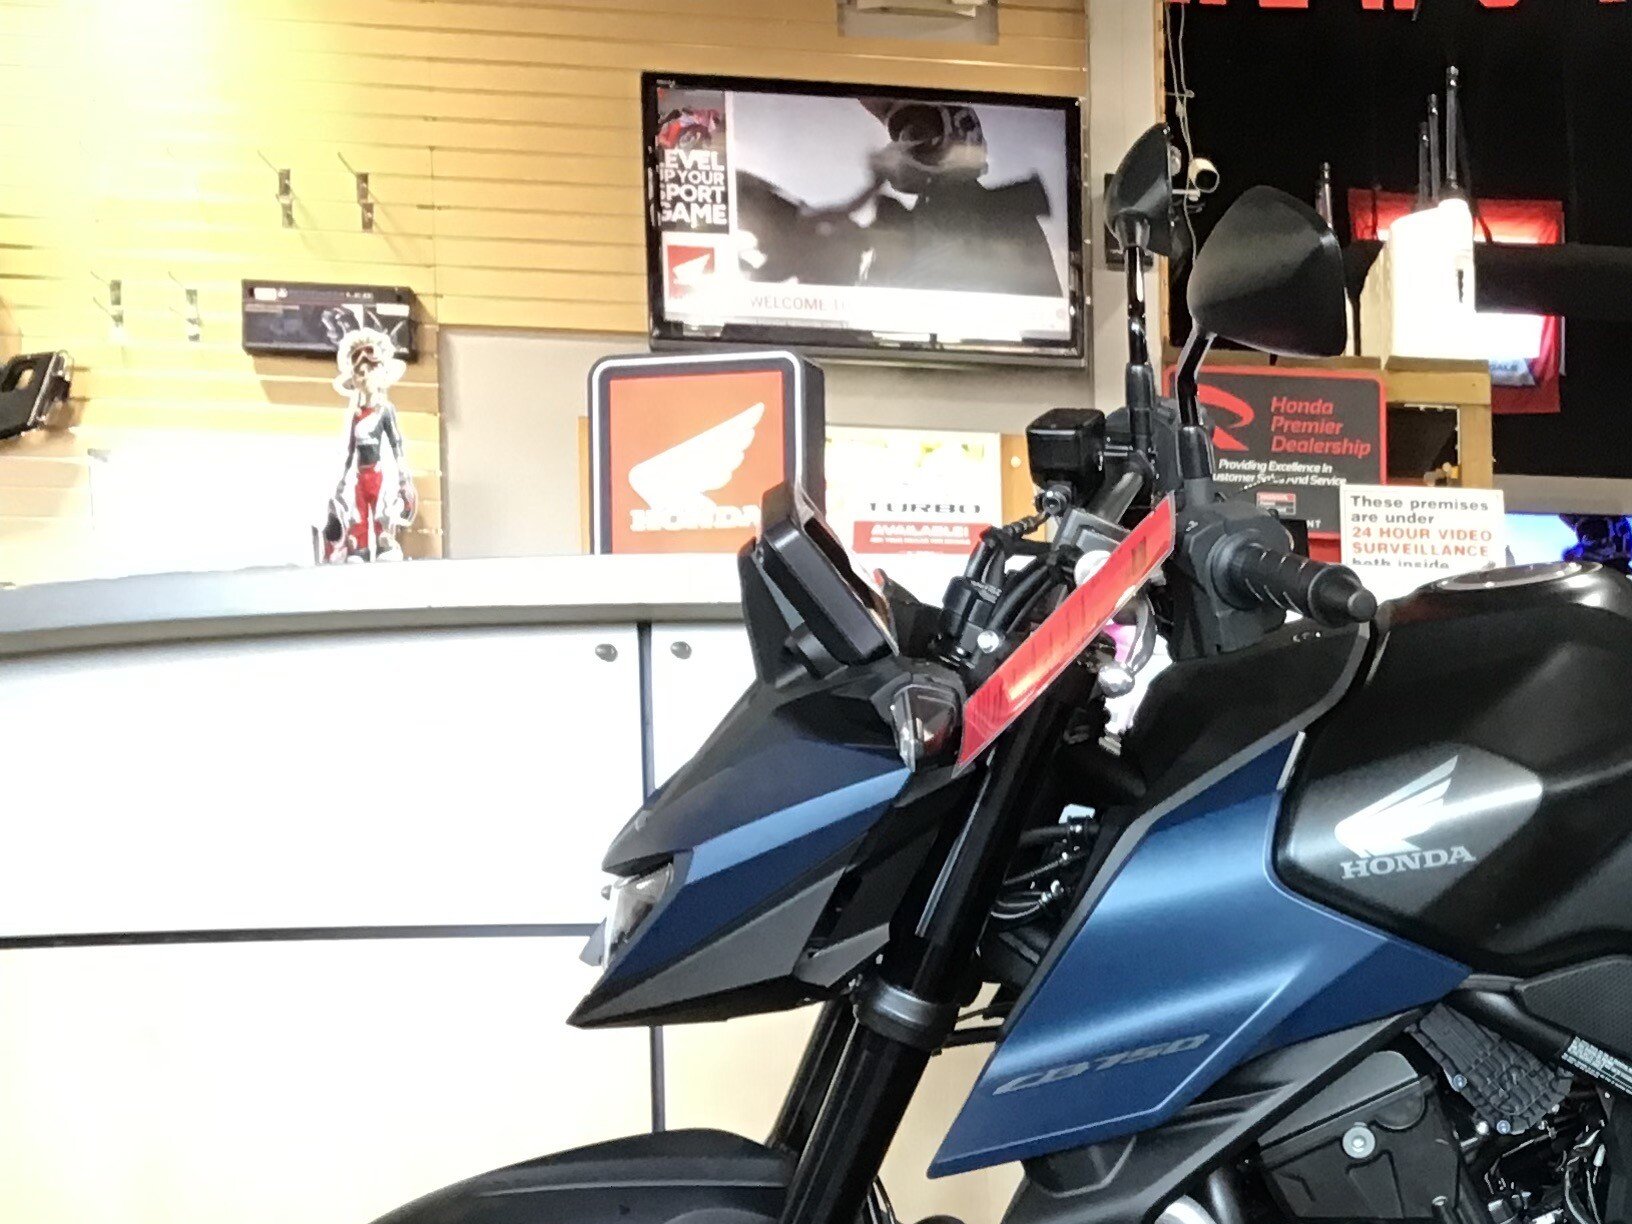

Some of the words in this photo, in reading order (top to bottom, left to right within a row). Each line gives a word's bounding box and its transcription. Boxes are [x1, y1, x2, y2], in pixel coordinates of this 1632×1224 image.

[660, 149, 725, 171] EVEL
[677, 170, 725, 185] YOUR
[1271, 397, 1334, 415] Honda
[1271, 416, 1344, 435] Premier
[1271, 435, 1371, 459] Dealership
[1218, 458, 1267, 472] Providing
[1268, 460, 1321, 474] Excellence
[1213, 472, 1255, 483] ustomer
[1351, 495, 1403, 508] These
[1410, 499, 1489, 511] premises
[1351, 513, 1378, 522] are
[1385, 512, 1434, 524] under
[1352, 526, 1372, 538] 24
[1379, 527, 1430, 540] HOUR
[1438, 529, 1492, 542] VIDEO
[1352, 541, 1489, 557] SURVEILLANCE
[1341, 845, 1476, 880] HONDA
